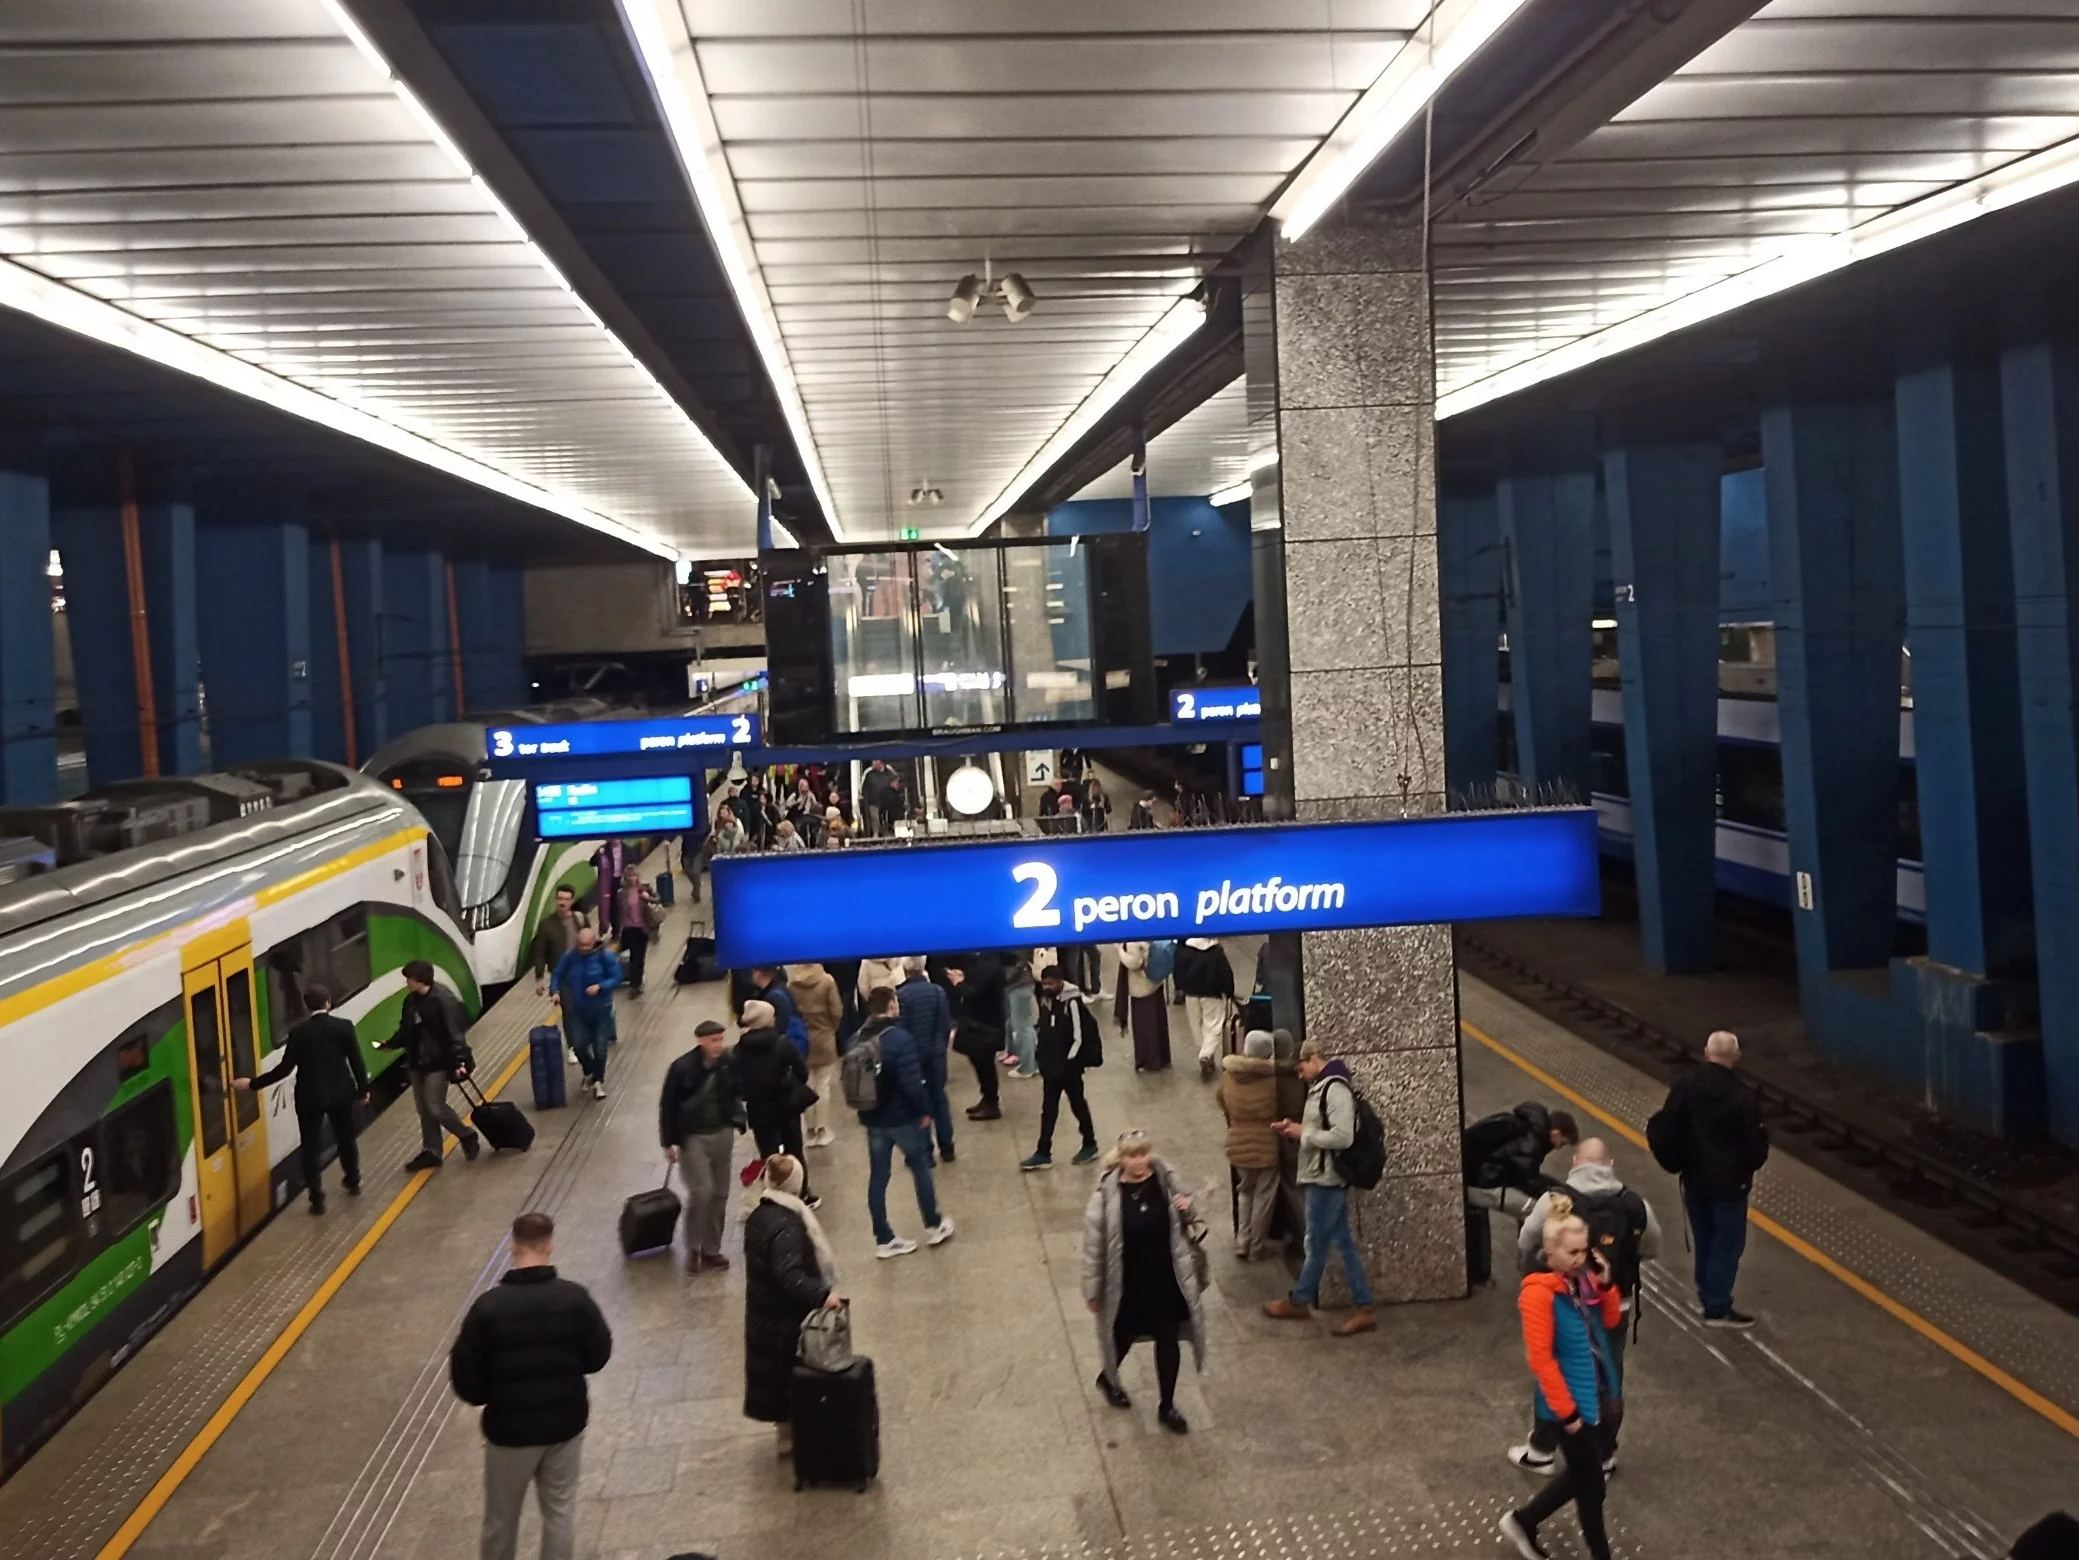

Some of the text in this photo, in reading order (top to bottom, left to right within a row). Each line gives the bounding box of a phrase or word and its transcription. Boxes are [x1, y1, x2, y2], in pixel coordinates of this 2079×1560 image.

[1176, 693, 1196, 719] 2
[493, 730, 515, 757] 3
[677, 732, 726, 749] platform
[731, 719, 752, 744] 2
[1011, 861, 1345, 932] 2 peron platform
[81, 1147, 97, 1194] 2
